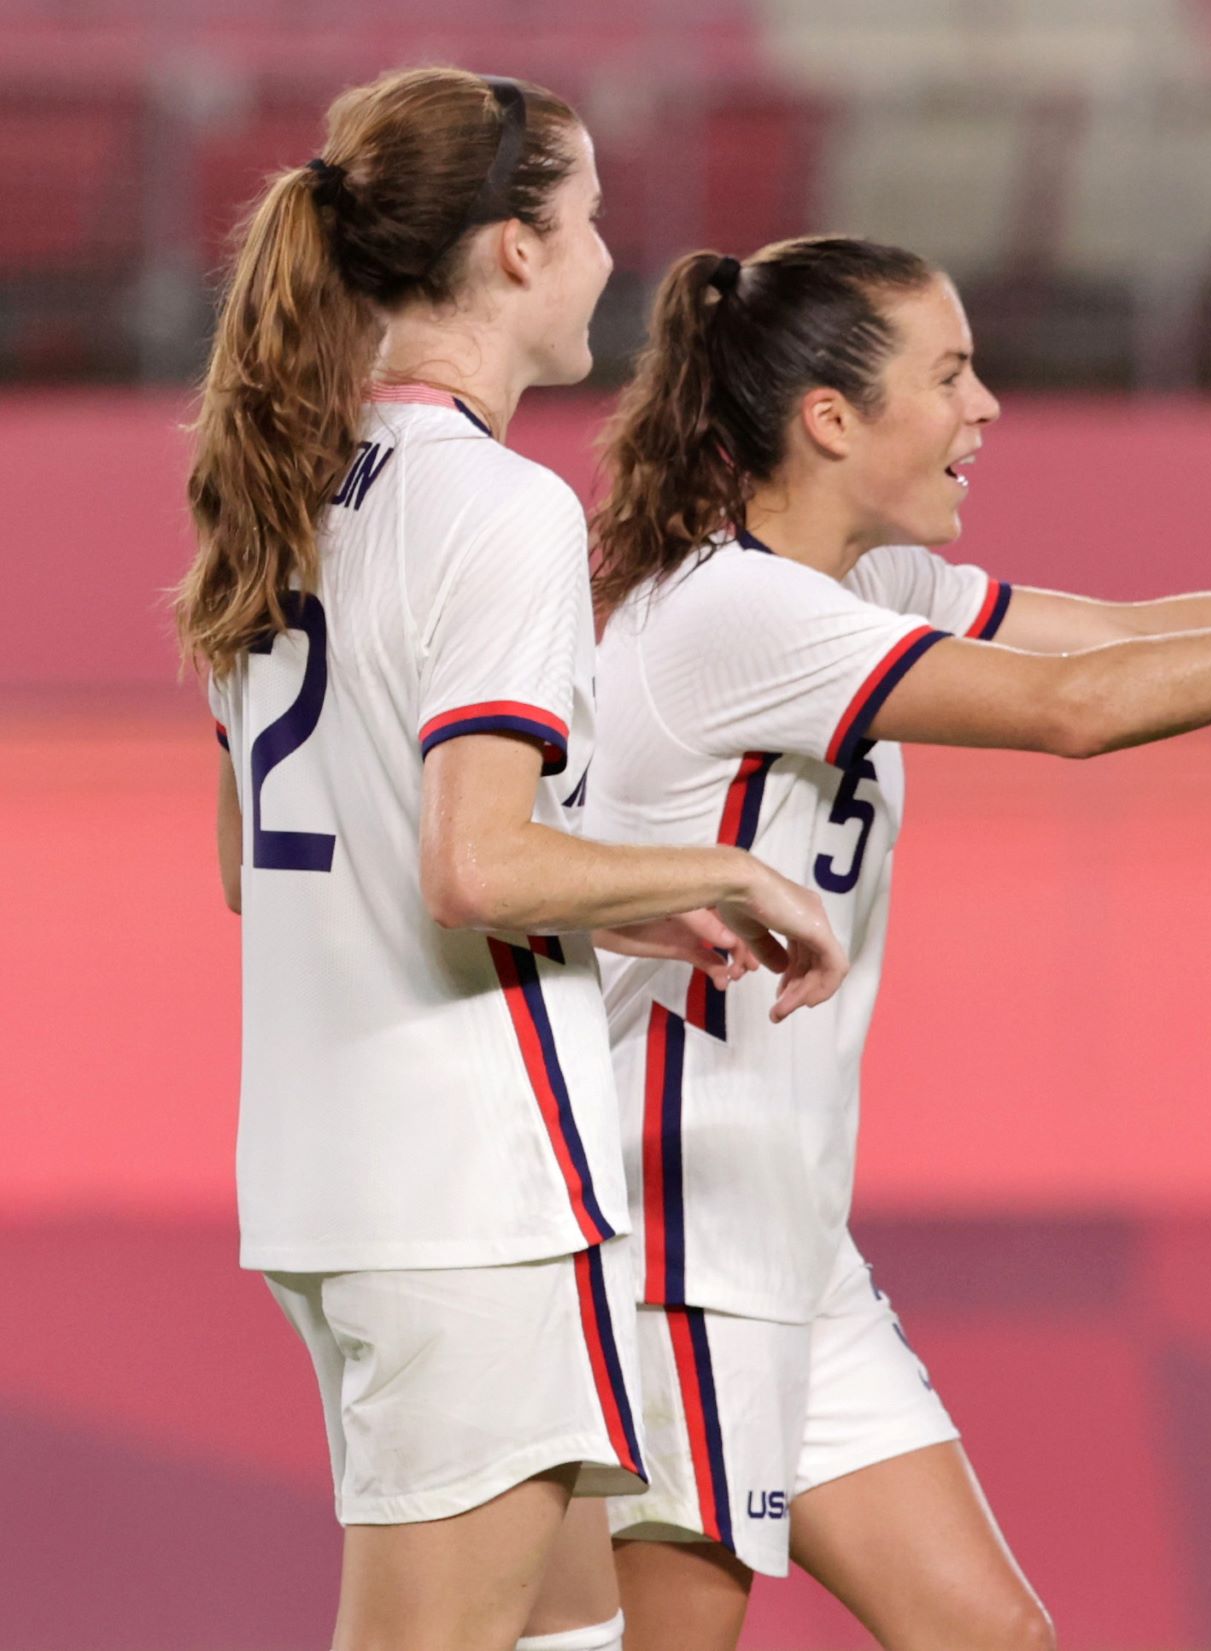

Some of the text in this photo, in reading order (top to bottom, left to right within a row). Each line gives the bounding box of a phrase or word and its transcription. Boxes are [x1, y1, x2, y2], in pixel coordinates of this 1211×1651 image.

[248, 590, 337, 872] 2
[814, 757, 878, 895] 5
[747, 1490, 789, 1519] US
